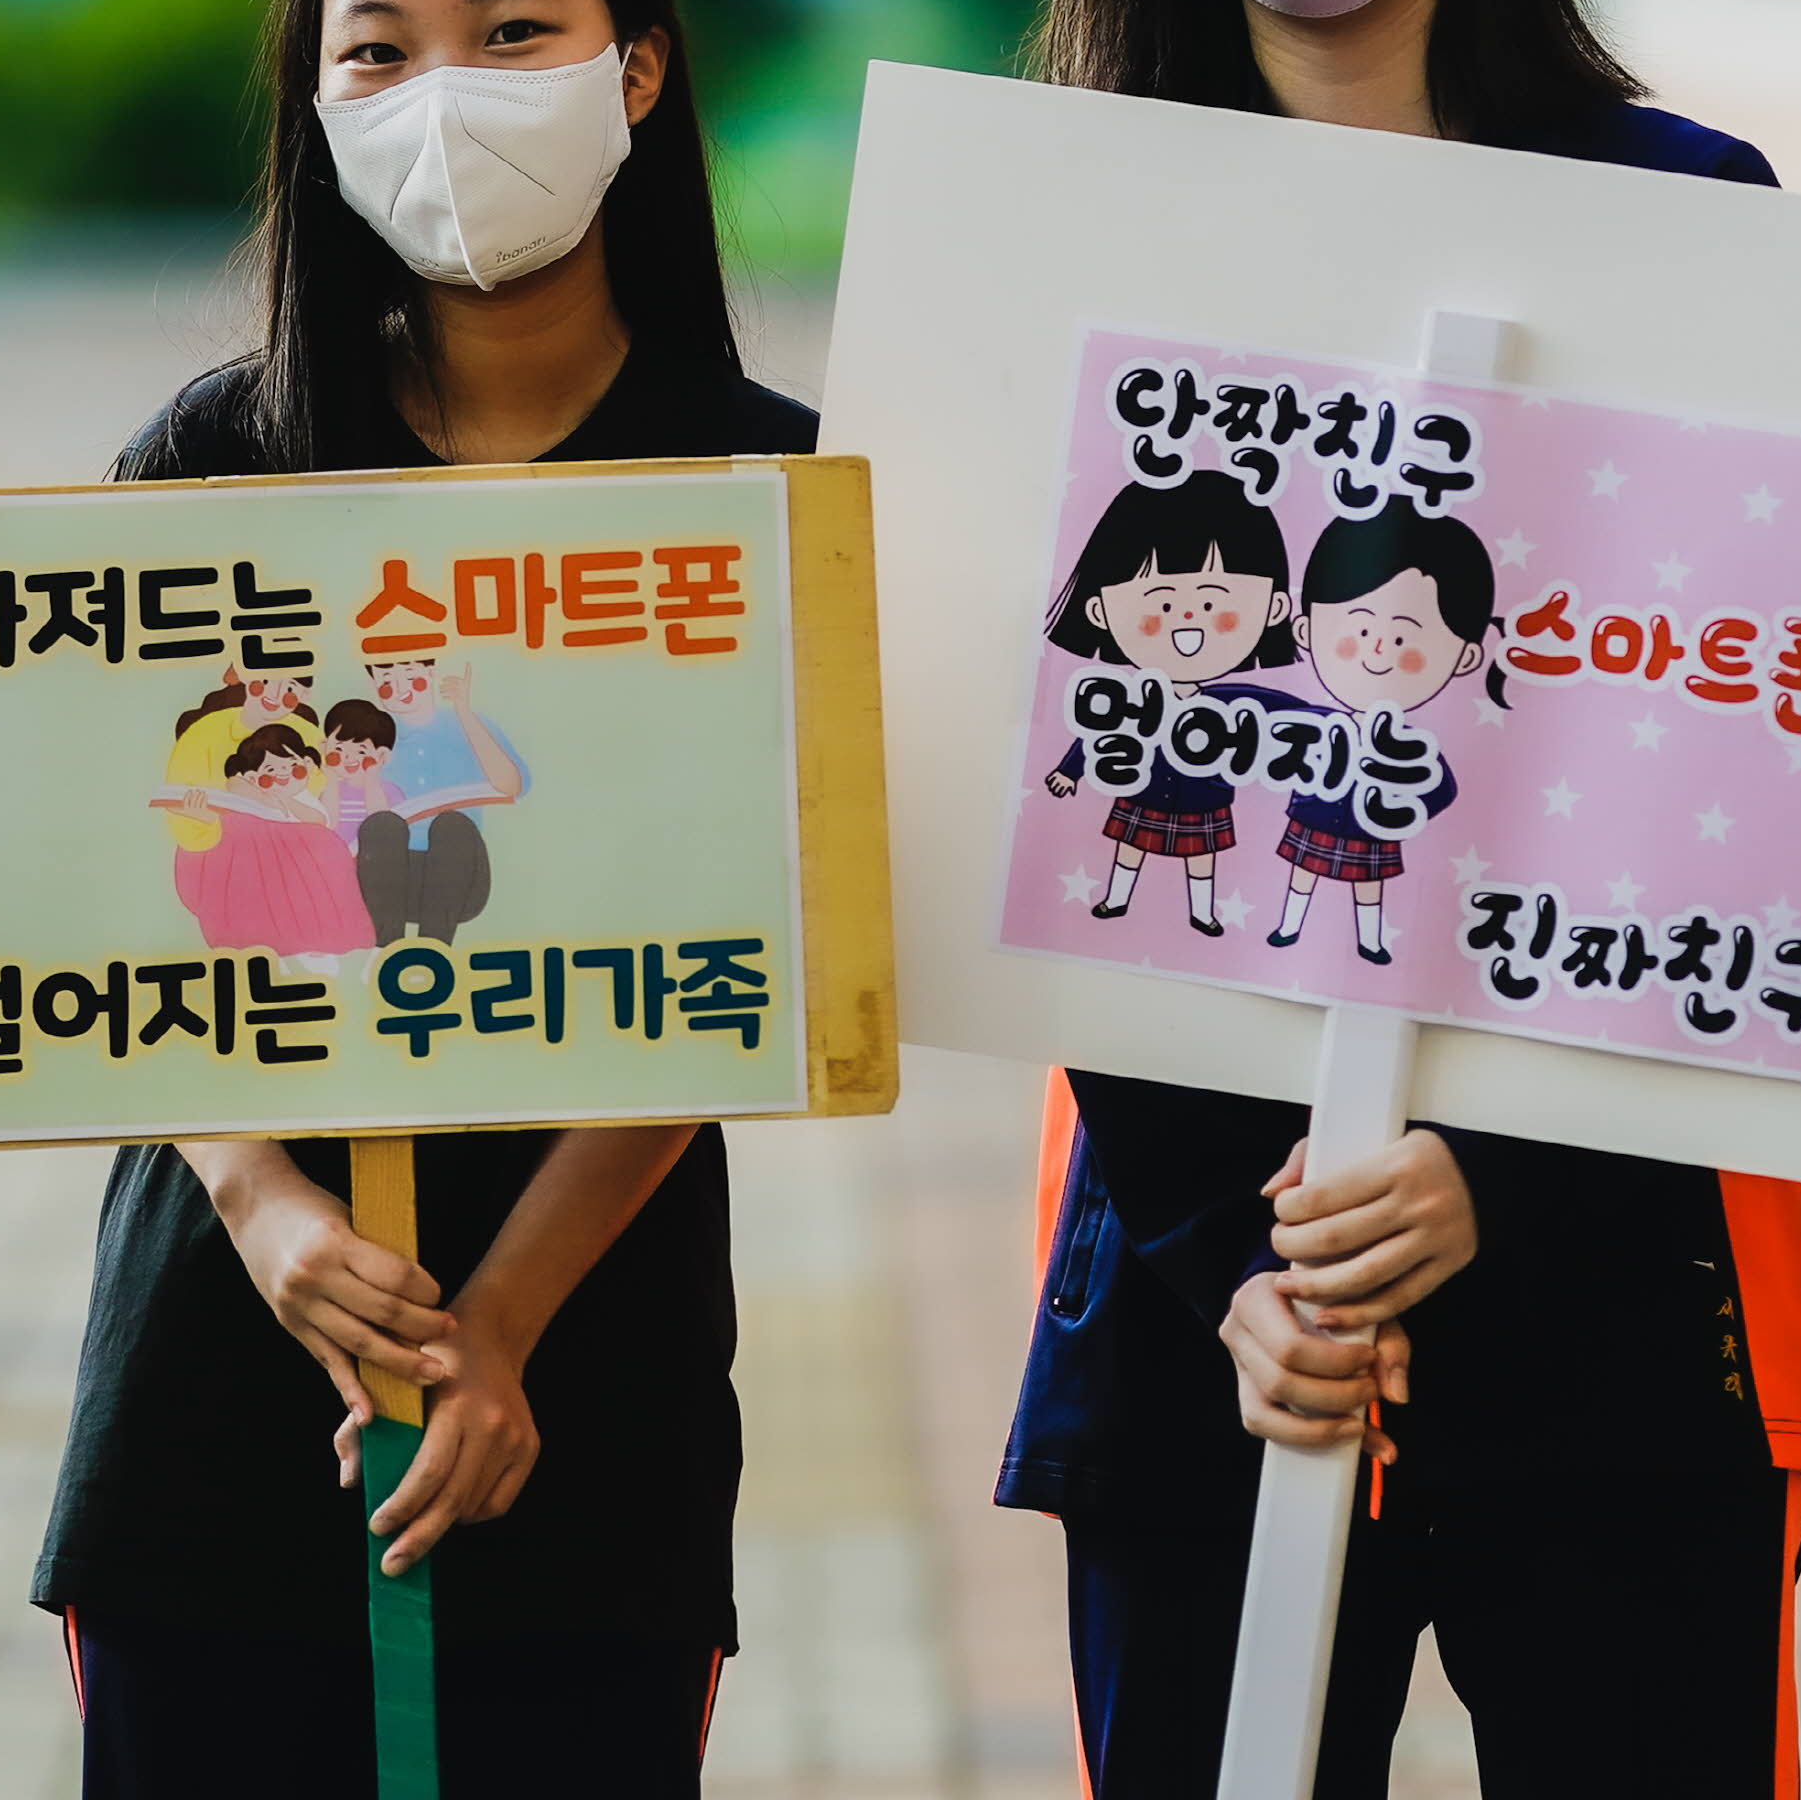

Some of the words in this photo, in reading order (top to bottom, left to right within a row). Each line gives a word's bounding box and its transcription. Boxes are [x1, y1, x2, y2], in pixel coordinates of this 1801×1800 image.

[1116, 364, 1478, 506] 단짝친구
[354, 544, 745, 656] 스마트폰
[1073, 676, 1442, 827] 멀어지는
[374, 936, 770, 1057] 우리가족
